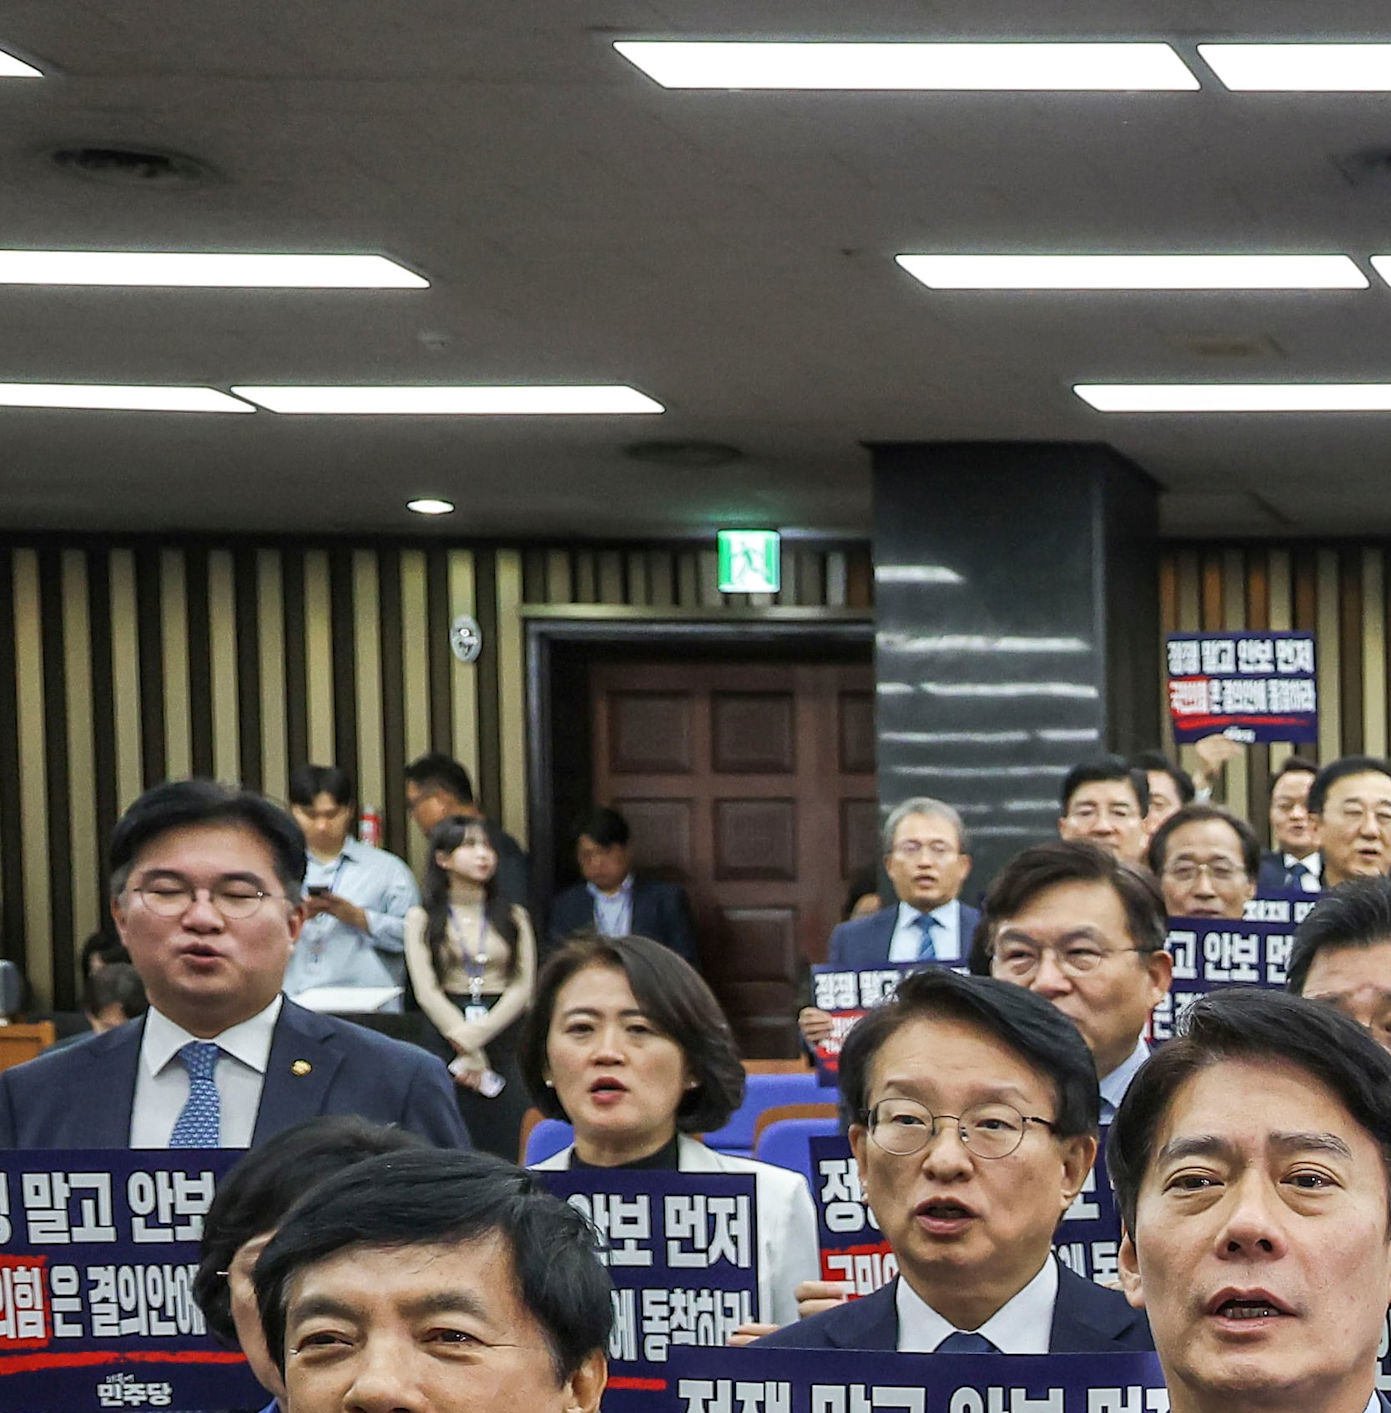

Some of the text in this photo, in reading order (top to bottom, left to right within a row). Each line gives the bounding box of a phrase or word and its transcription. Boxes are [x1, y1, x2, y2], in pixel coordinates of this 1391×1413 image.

[1203, 932, 1260, 982] 안보
[22, 1171, 216, 1243] 말고 안보
[664, 1195, 751, 1268] 먼저
[51, 1265, 84, 1337] 은
[87, 1264, 208, 1337] 결의안에
[97, 1381, 173, 1407] 민주당
